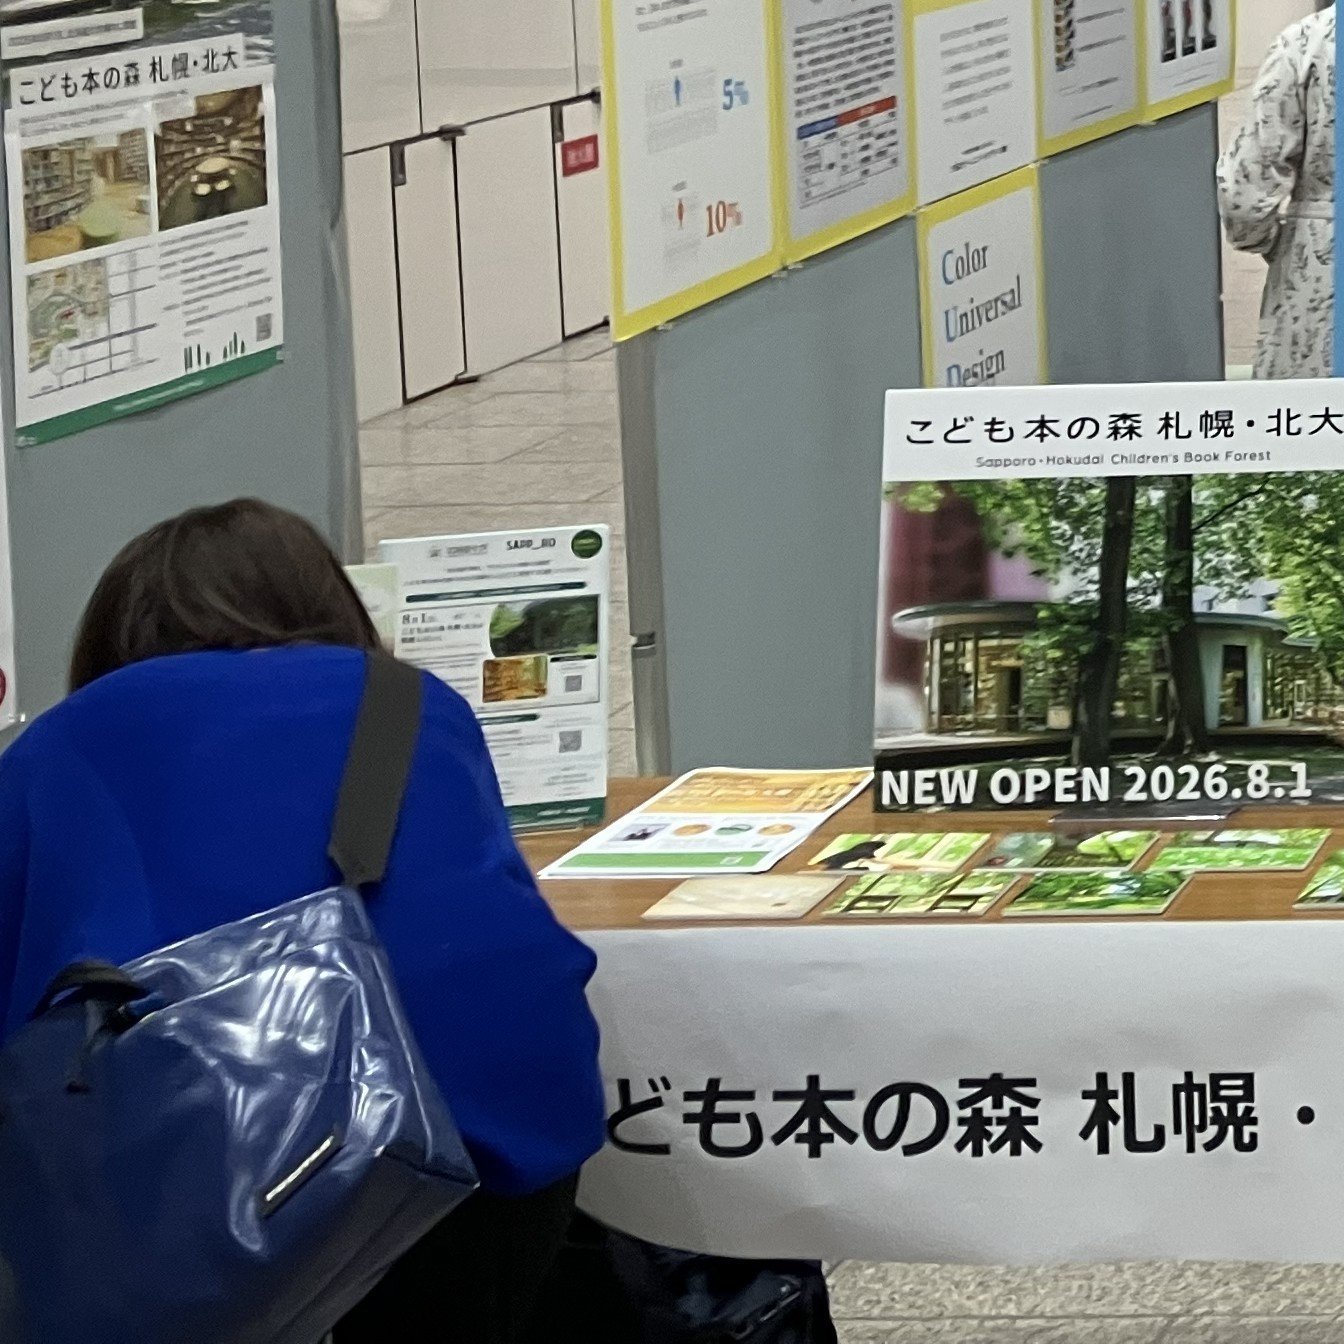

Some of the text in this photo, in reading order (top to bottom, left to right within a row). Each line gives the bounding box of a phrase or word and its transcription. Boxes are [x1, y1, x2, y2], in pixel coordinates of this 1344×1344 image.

[19, 46, 239, 105] こども本の森 札幌・北大
[942, 242, 989, 285] Color
[944, 273, 1022, 342] Universal
[946, 348, 1006, 387] Design
[904, 412, 1145, 445] こども本の森
[1111, 452, 1180, 465] Children's
[1184, 451, 1220, 463] Book
[1225, 450, 1272, 462] Forest
[881, 762, 1313, 806] NEW OPEN 2026.8.1
